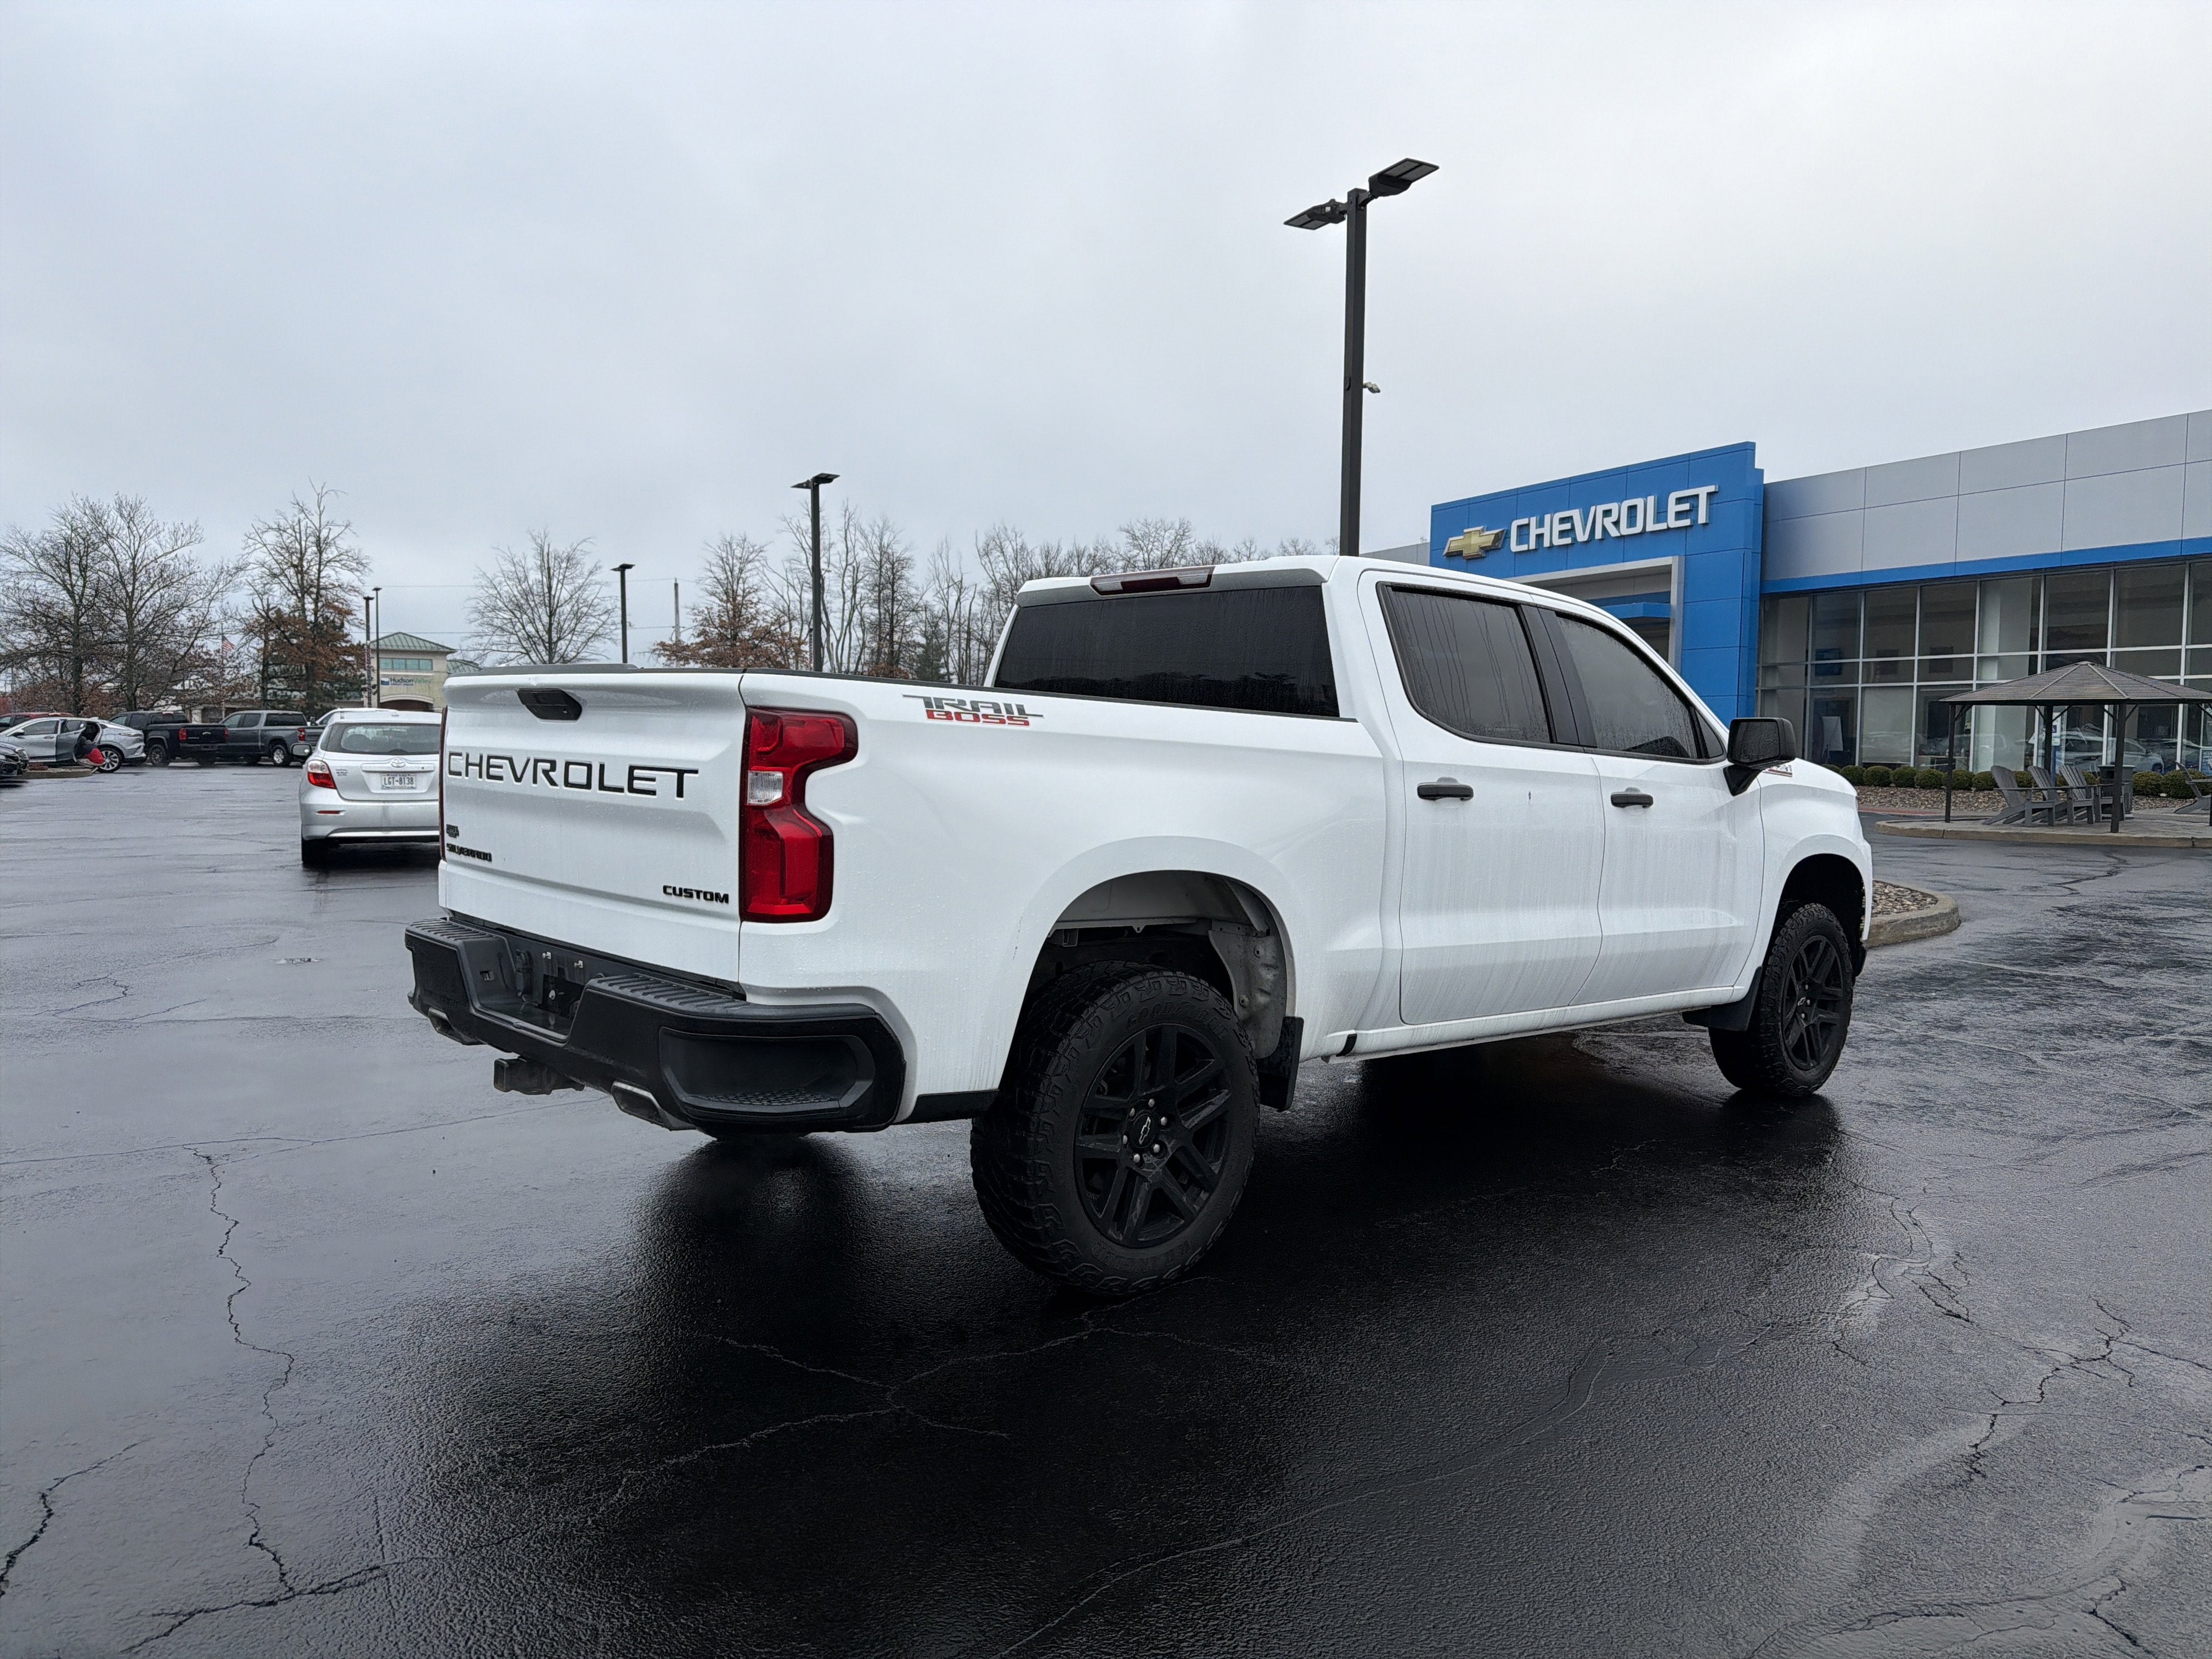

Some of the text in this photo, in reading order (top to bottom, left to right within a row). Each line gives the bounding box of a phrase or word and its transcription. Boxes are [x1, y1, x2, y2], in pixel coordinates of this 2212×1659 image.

[1510, 485, 1718, 552] CHEVROLET
[901, 694, 1044, 718] TRAIL
[926, 709, 1030, 726] BOSS
[448, 752, 699, 799] CHEVROLET
[663, 885, 729, 904] CUSTOM
